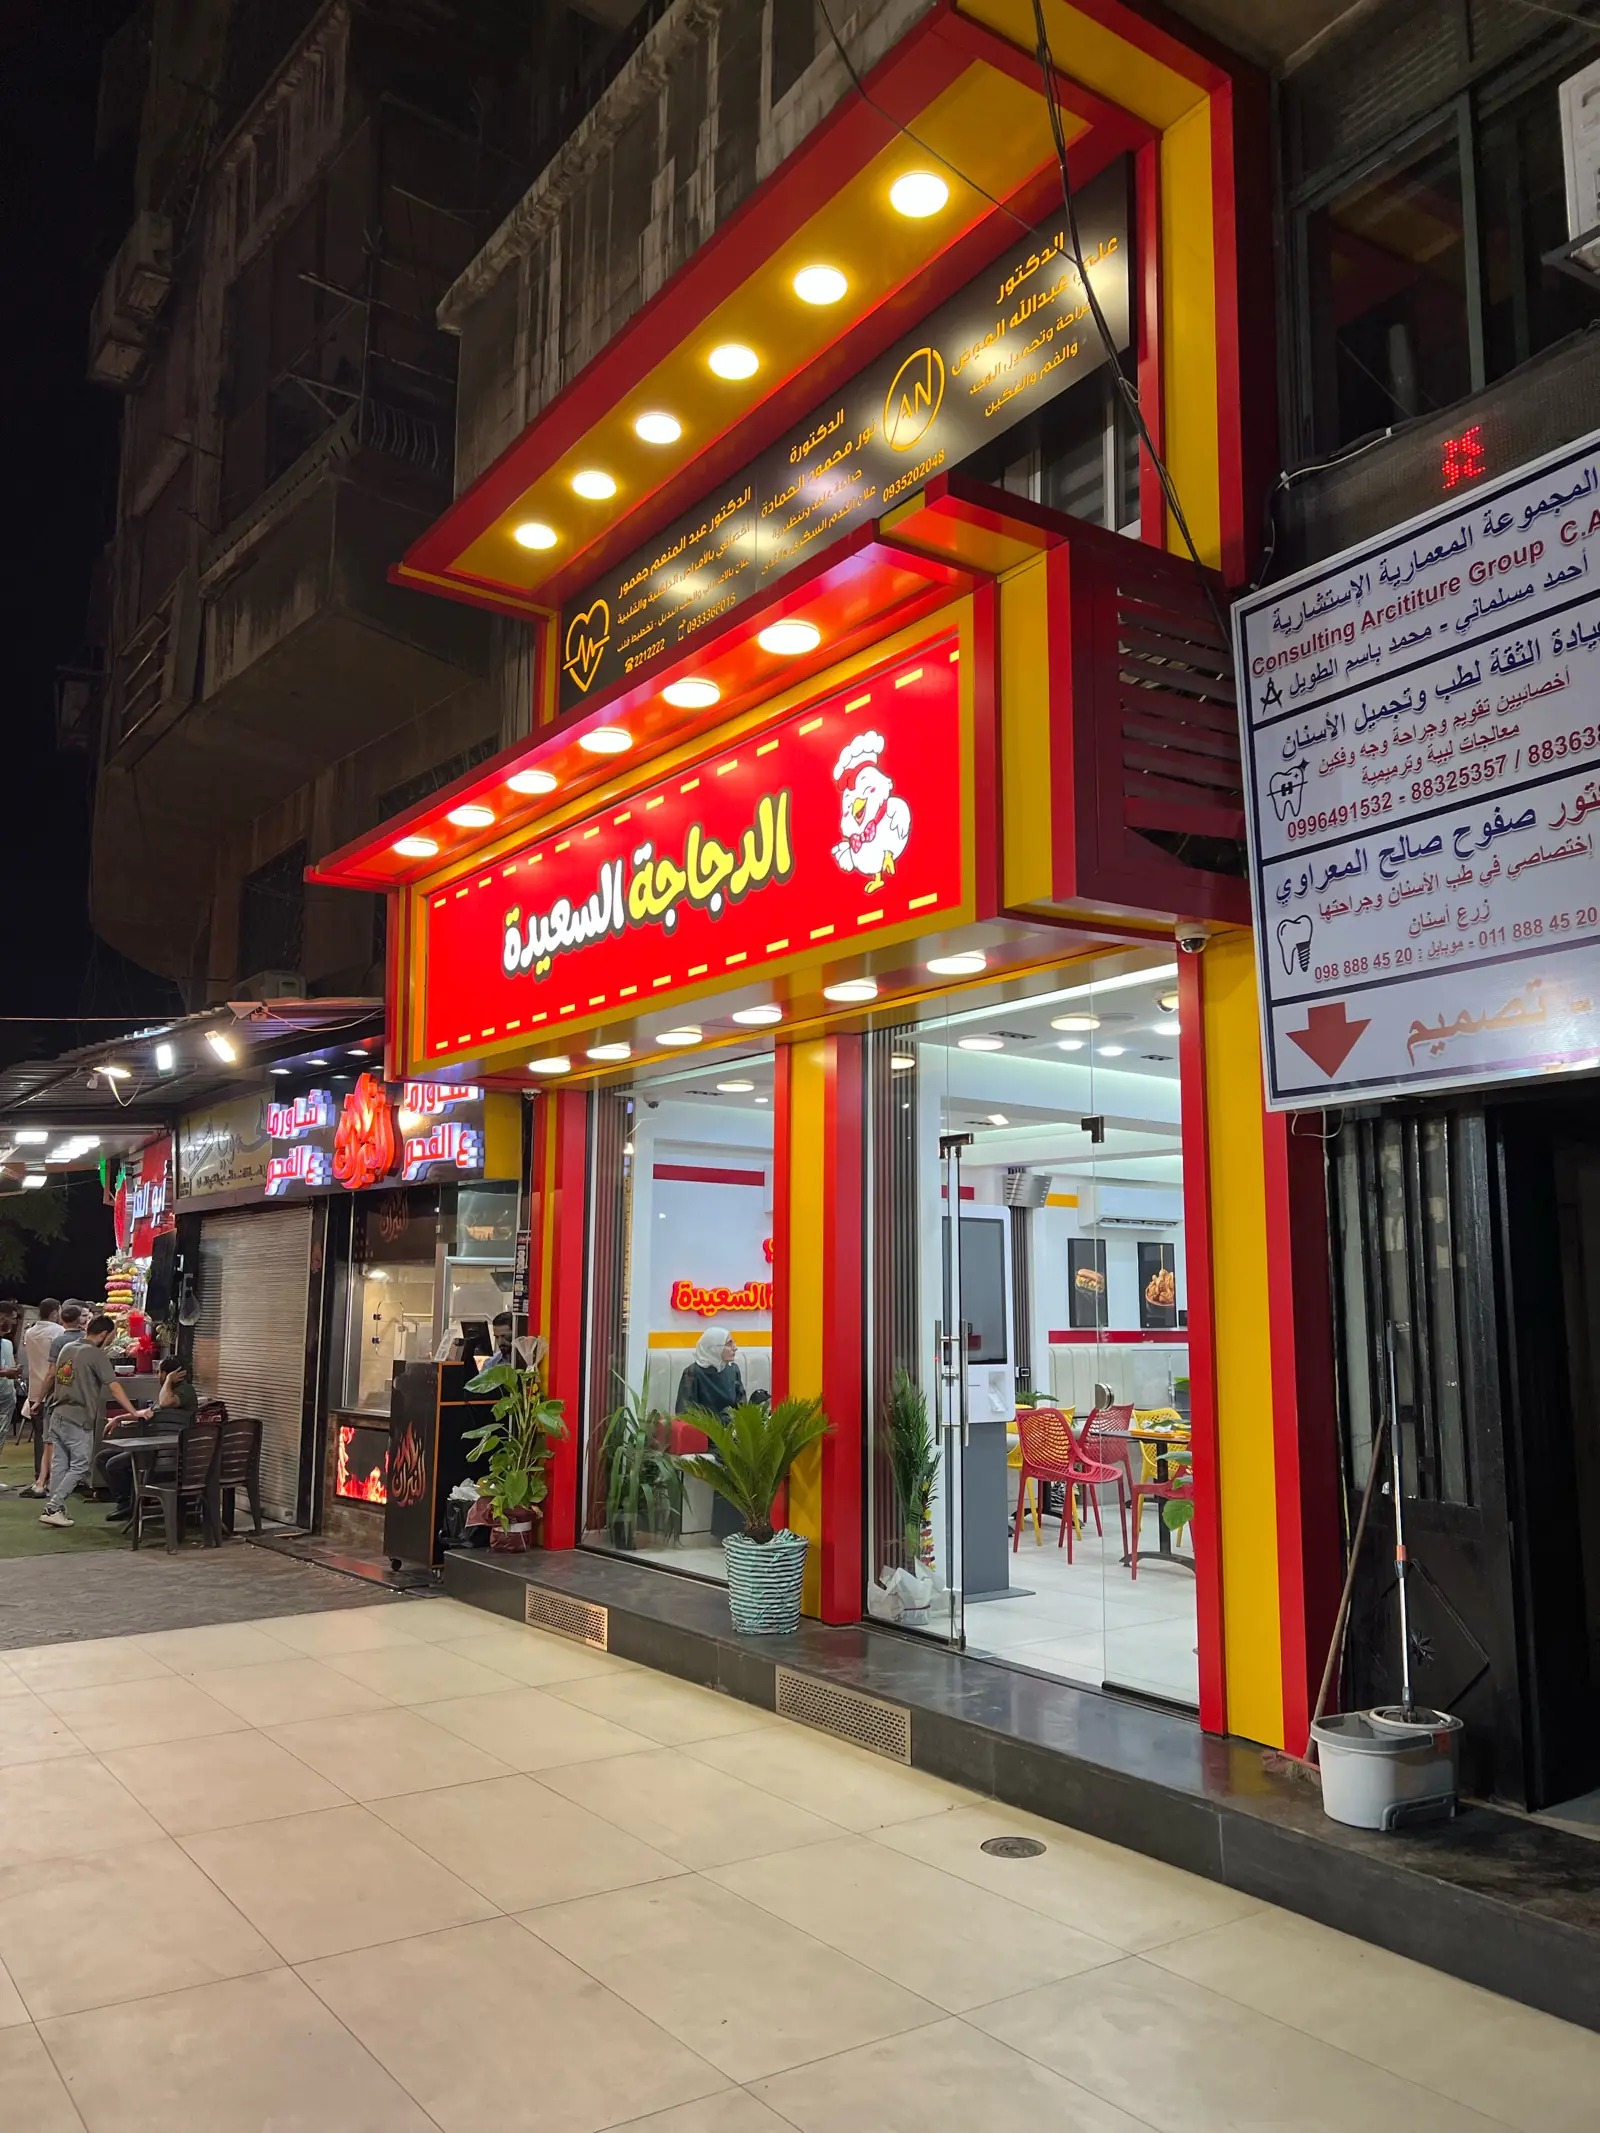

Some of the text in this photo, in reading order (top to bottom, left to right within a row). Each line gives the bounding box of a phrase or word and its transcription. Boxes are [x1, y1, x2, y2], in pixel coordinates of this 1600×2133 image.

[997, 231, 1064, 304] الدكتور
[984, 341, 1078, 417] والفم والفكين
[789, 408, 845, 464] الدكتورة
[761, 419, 877, 519] نور محمود الحمادة
[883, 448, 945, 503] 0935202048
[688, 525, 707, 546] عبد
[708, 486, 751, 533] الدكتور
[650, 536, 686, 575] المنعم
[1273, 466, 1598, 635] المجموعة المعمارية الإستشارية
[1252, 622, 1355, 676] Consulting
[1361, 576, 1461, 632] Arcititure
[1468, 540, 1545, 584] Group
[1289, 547, 1588, 697] أحمد مسلماني محمد باسم الطويل
[634, 638, 665, 668] 2212222
[1490, 638, 1541, 674] الثقة
[1435, 660, 1482, 700] لطب
[1282, 712, 1346, 759] الأسنان
[1354, 687, 1427, 731] وتجميل
[1392, 718, 1447, 744] وجراحة
[1452, 698, 1491, 730] تقويم
[1318, 747, 1355, 776] وفكين
[1360, 740, 1388, 757] وجه
[1362, 724, 1520, 785] معالجات لبية وترميمية
[1287, 791, 1393, 839] 0996491532
[1411, 754, 1507, 801] 88325357
[1276, 781, 1600, 907] تور صفوح صالح المعراوي
[502, 789, 793, 976] الدجاجة السعيدة
[1318, 832, 1593, 921] إختصاصي في طب الأسنان وجراحتها
[1315, 907, 1598, 981] 011 888 45 20 موبايل 098 888 45 20
[1408, 899, 1491, 937] زرع أسنان
[1406, 976, 1547, 1068] تصميم
[267, 1089, 330, 1139] شاورما
[265, 1145, 307, 1196] الفحم
[402, 1122, 474, 1181] ع الفحم
[672, 1280, 766, 1317] السعيدة
